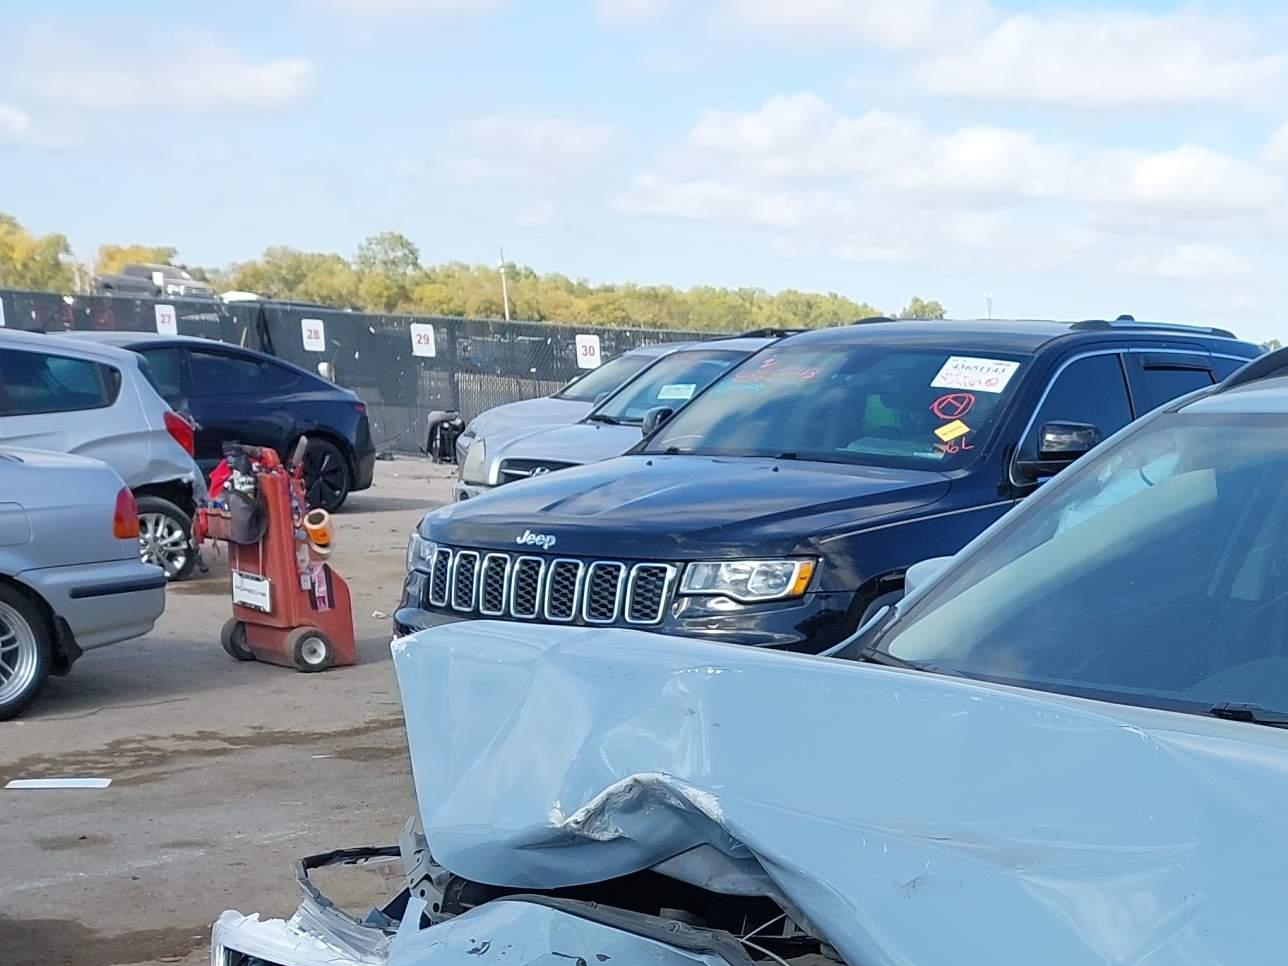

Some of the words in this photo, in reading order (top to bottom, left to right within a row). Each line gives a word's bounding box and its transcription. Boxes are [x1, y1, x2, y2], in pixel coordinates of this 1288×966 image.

[159, 313, 172, 324] 27
[307, 329, 320, 341] 28
[416, 334, 430, 346] 29
[581, 345, 595, 357] 30
[516, 529, 557, 550] Jeep
